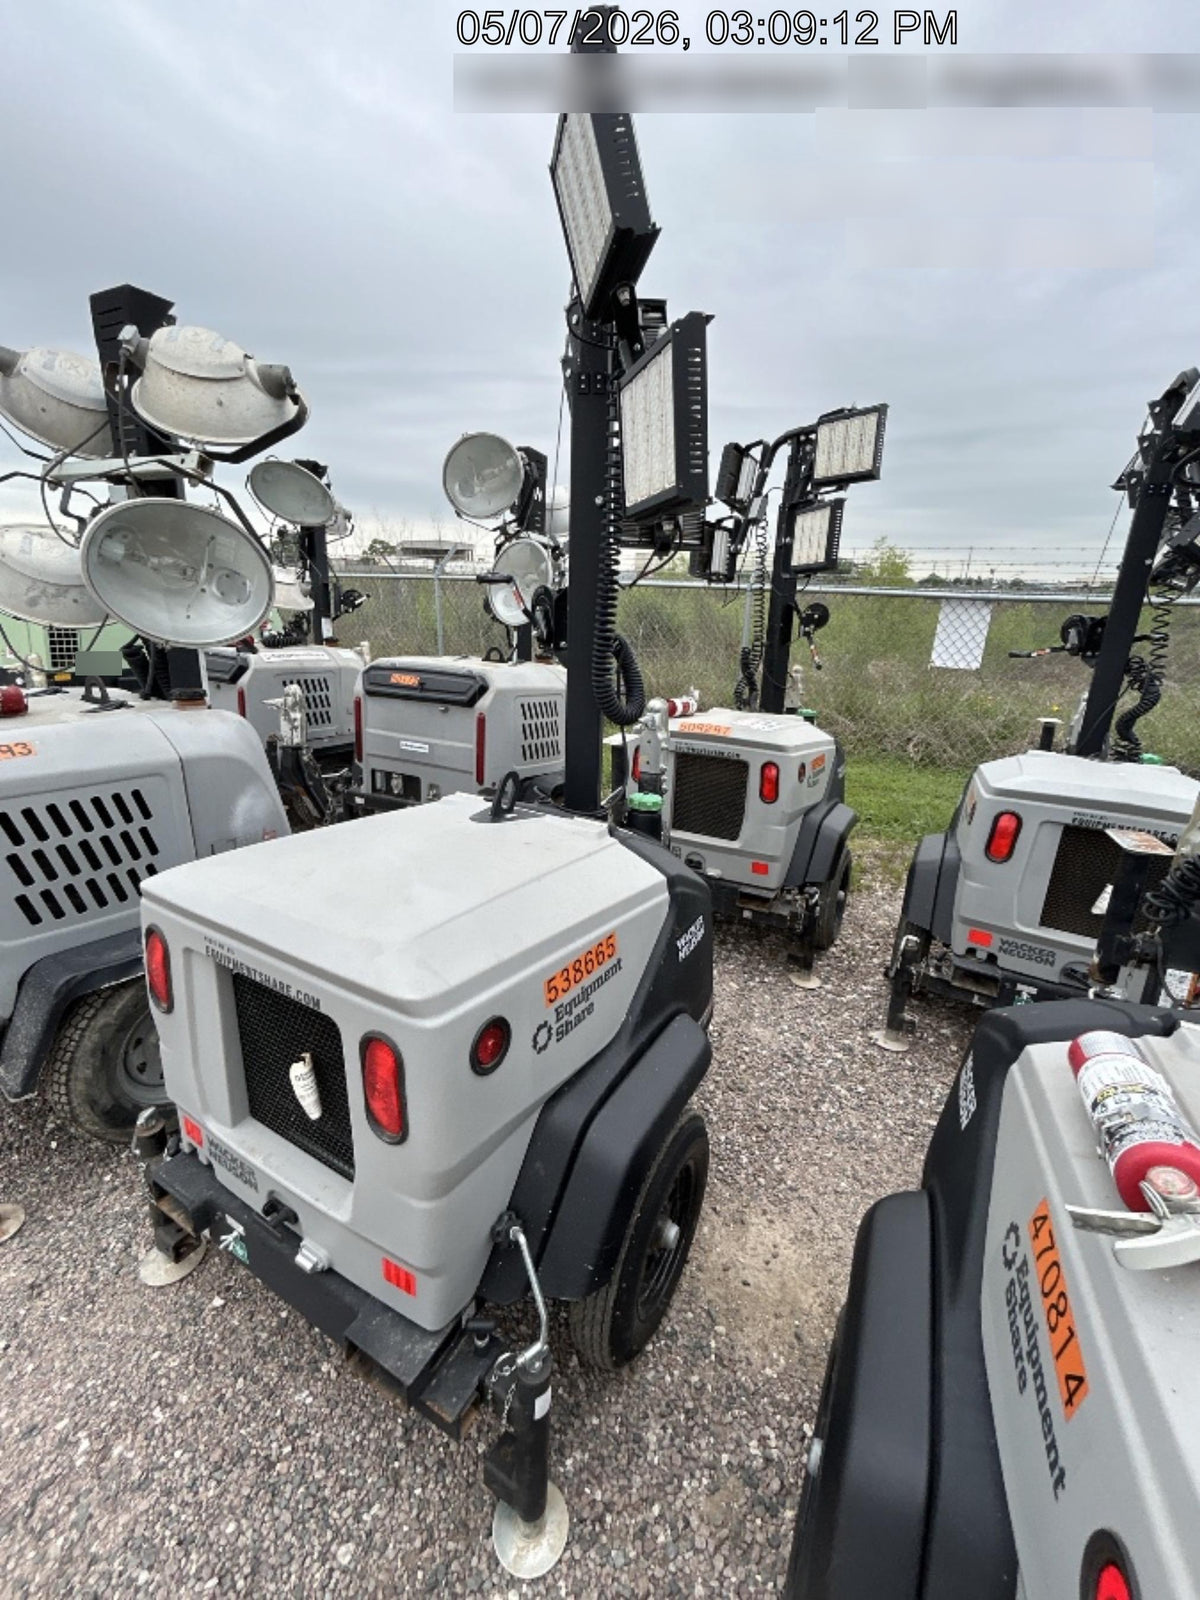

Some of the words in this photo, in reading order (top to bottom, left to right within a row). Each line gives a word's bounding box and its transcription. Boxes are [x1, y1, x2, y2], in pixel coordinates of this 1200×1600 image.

[205, 945, 321, 1010] EQUIPMENTSHARE.COM
[546, 934, 616, 1003] 538665
[998, 945, 1056, 968] NEUSON
[1000, 937, 1056, 957] WACKER
[554, 957, 623, 1024] Equipment
[556, 1001, 595, 1043] Share
[1005, 1278, 1027, 1395] Share
[1032, 1214, 1085, 1408] 470814
[1015, 1253, 1066, 1502] Equipment
